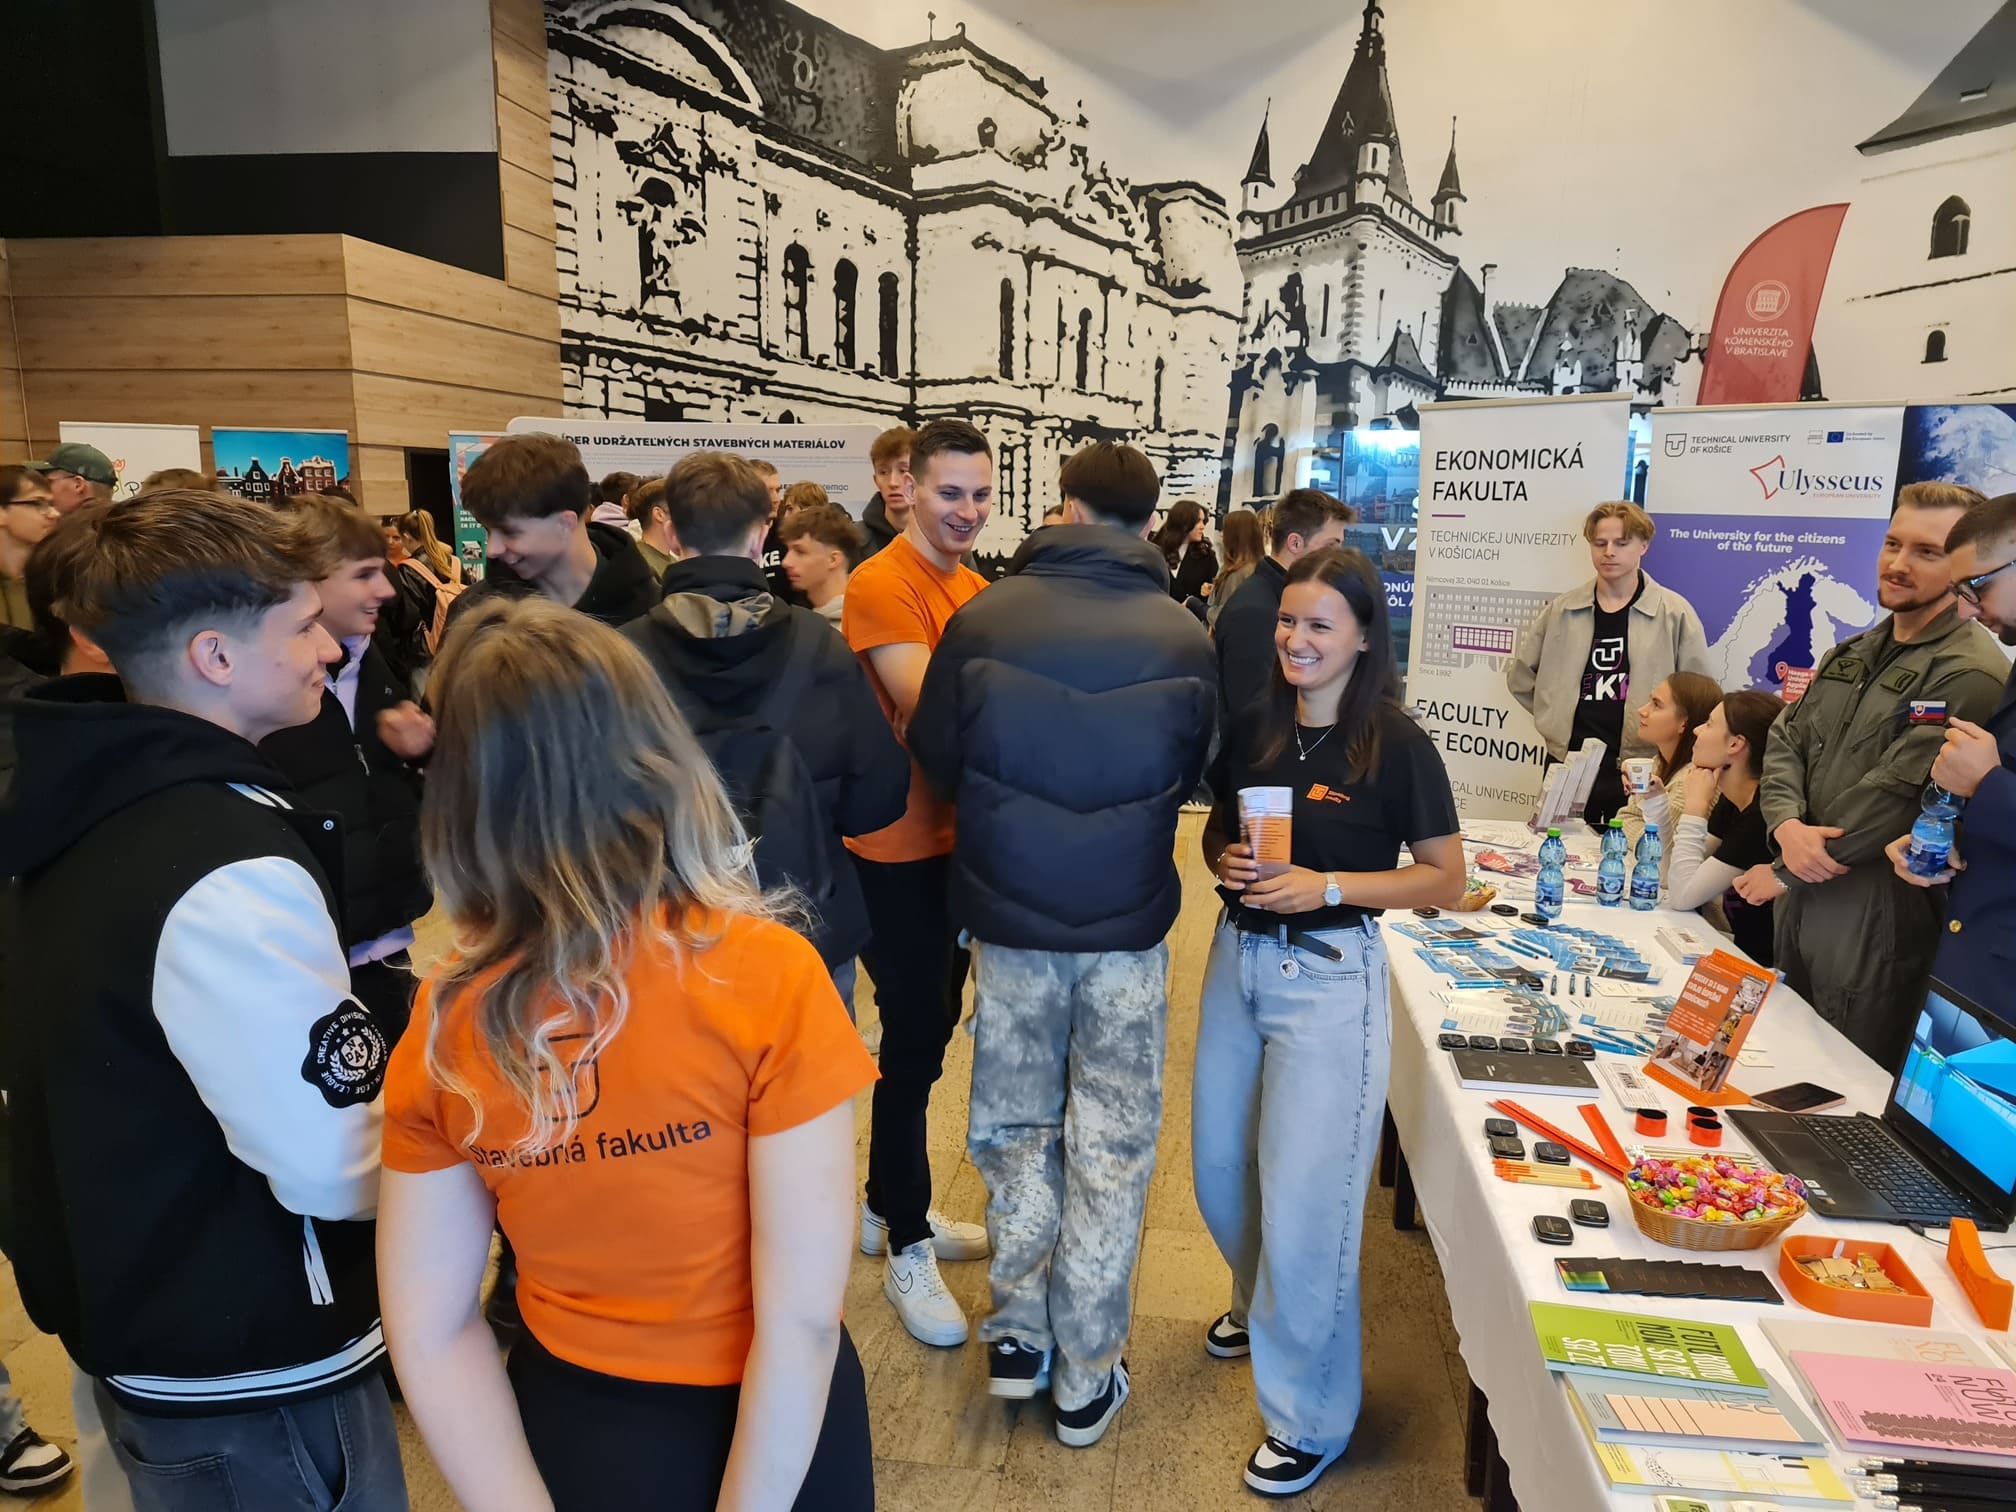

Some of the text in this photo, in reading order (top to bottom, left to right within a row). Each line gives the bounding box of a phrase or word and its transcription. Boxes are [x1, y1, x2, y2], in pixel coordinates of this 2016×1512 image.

[1732, 327, 1790, 337] UNIVERZITA
[1724, 336, 1794, 348] KOMENSKÉHO
[1734, 347, 1789, 358] BRATISLAVE
[593, 435, 690, 447] UDRŽATEĽNÝCH
[693, 437, 770, 449] STAVEBNÝCH
[773, 438, 846, 449] MATERIÁLOV
[1691, 434, 1791, 444] TECHNICAL UNIVERSITY
[1434, 442, 1584, 471] EKONOMICKÁ
[1690, 443, 1732, 454] OF KOŠICE
[1779, 468, 1884, 495] Ulysseus
[1432, 481, 1529, 501] FAKULTA
[1430, 530, 1577, 546] TECHNICKEJ UNIVERZITY
[1670, 528, 1846, 544] The University for the citizens
[1429, 547, 1500, 560] V KOŠICIACH
[1717, 540, 1792, 553] of the future
[760, 550, 780, 568] KE
[1416, 699, 1510, 729] FACULTY
[1446, 732, 1545, 766] ECONOMI
[1475, 783, 1537, 807] UNIVERSIT
[317, 1021, 340, 1064] CREATIVE
[596, 1120, 711, 1160] fakulta
[1635, 1321, 1679, 1347] NOW
